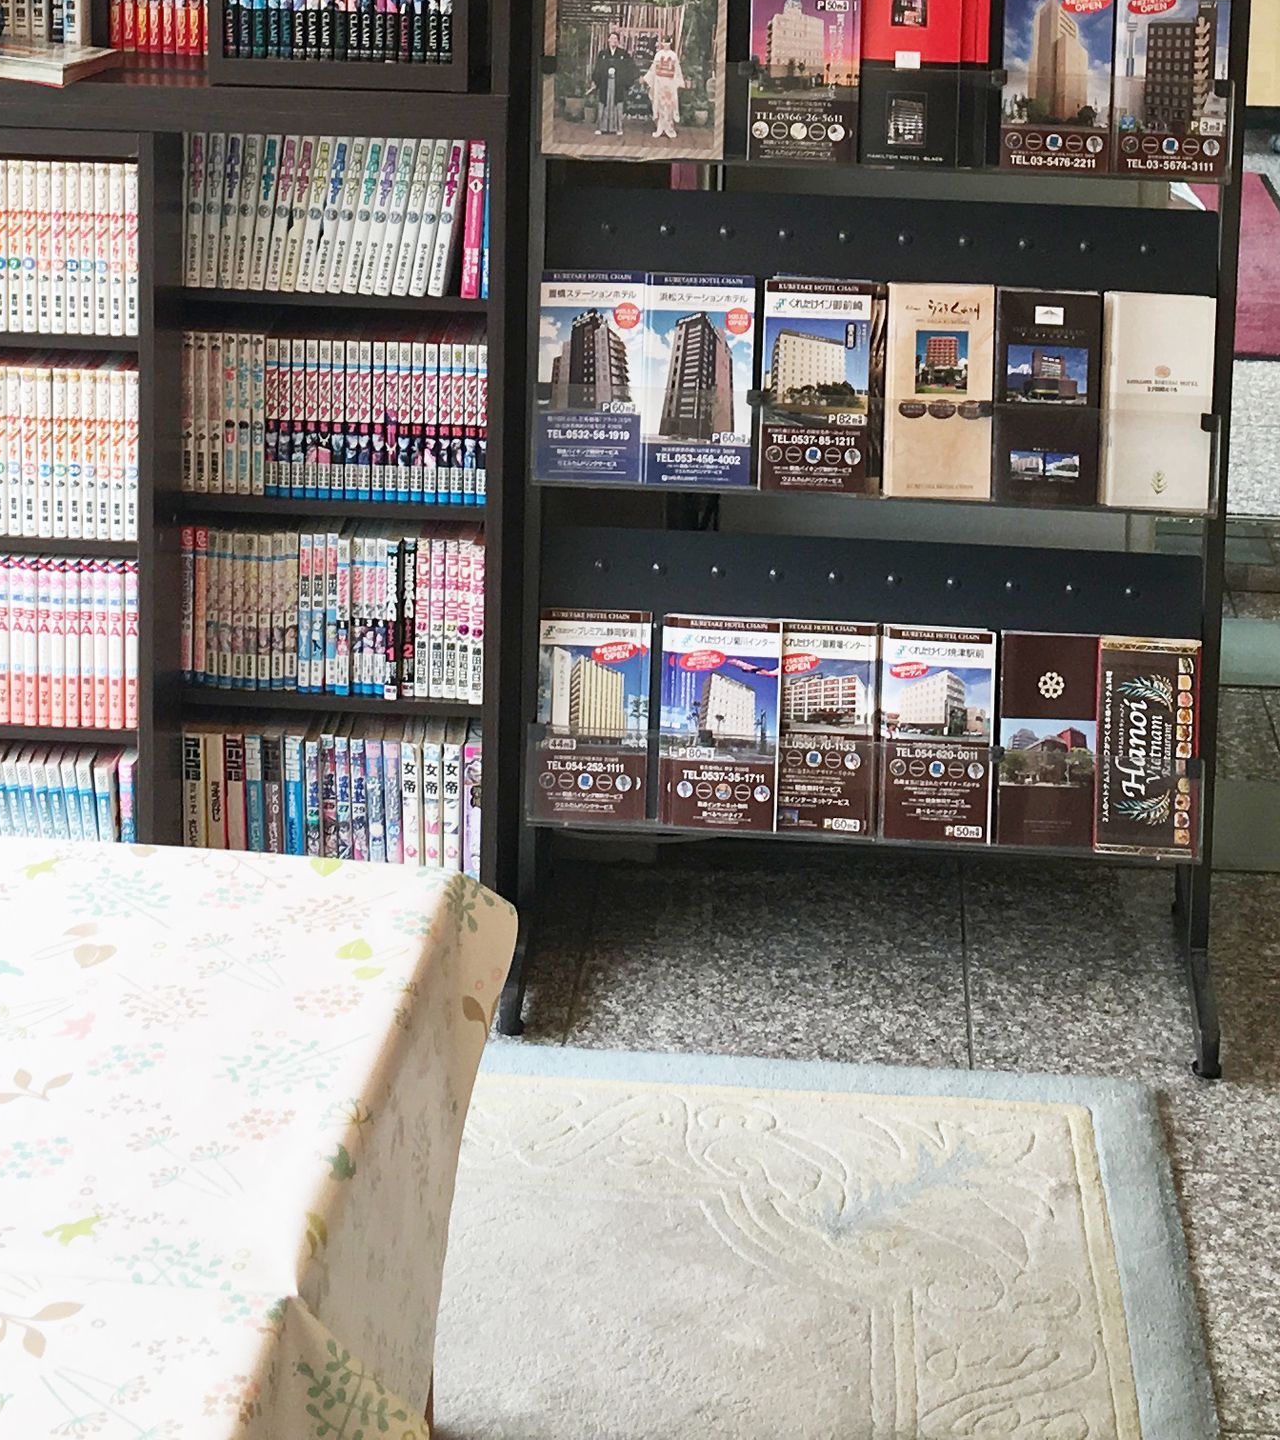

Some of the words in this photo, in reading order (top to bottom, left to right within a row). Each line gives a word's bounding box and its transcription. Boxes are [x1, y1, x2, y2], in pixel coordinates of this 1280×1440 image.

[1074, 1, 1103, 12] OPEN
[1140, 3, 1168, 13] OPEN
[295, 12, 303, 46] CLAMP
[321, 12, 330, 46] CLAMP
[362, 13, 371, 48] CLAMP
[441, 15, 450, 51] CLAMP
[788, 298, 863, 310] くれたけイン御前崎
[403, 644, 414, 658] 2
[603, 650, 630, 660] OPEN
[784, 663, 810, 672] OPEN
[1115, 697, 1149, 799] Hanoi
[1145, 714, 1164, 785] Vietnam
[403, 762, 416, 794] 女帝
[425, 762, 438, 795] 女帝
[445, 762, 458, 794] 女帝
